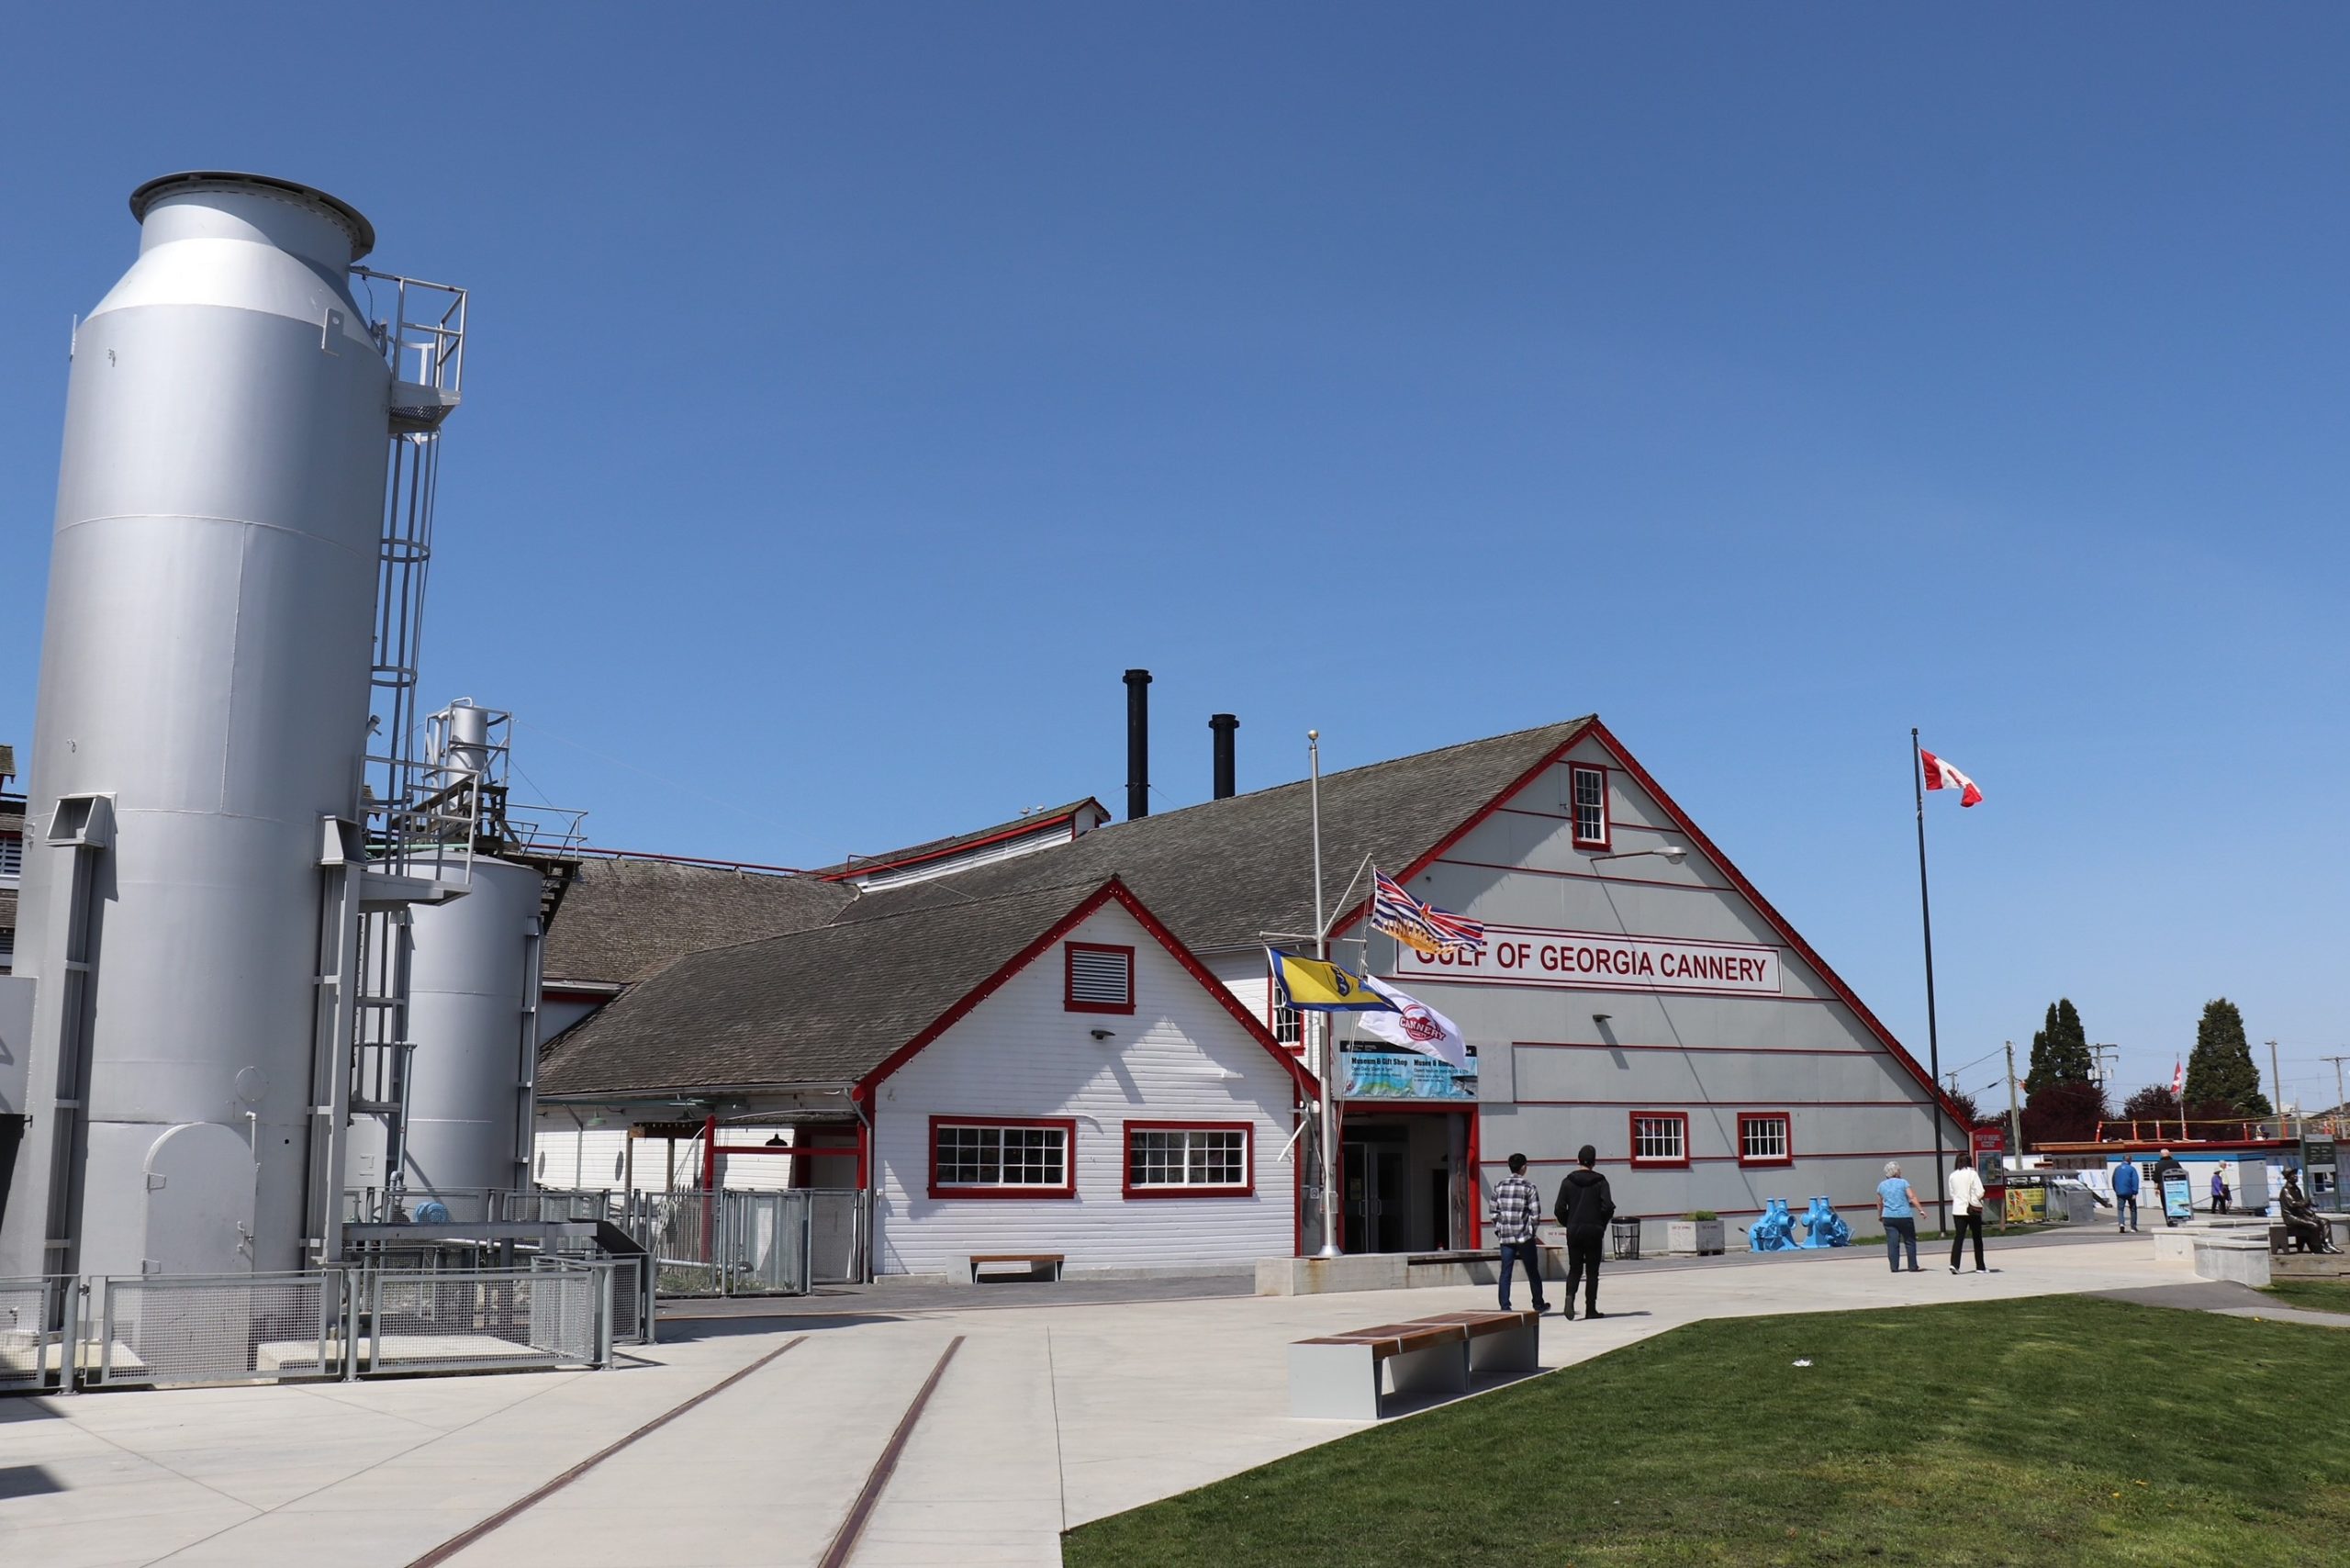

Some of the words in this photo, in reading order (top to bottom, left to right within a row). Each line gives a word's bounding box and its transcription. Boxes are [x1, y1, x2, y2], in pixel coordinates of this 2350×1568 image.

[1496, 942, 1531, 969] OF
[1539, 945, 1655, 976] GEORGIA
[1660, 952, 1766, 982] CANNERY
[1399, 1016, 1446, 1040] CANNERY
[1351, 1057, 1376, 1065] Museum
[1382, 1058, 1393, 1066] Gift
[1393, 1058, 1408, 1068] Shop
